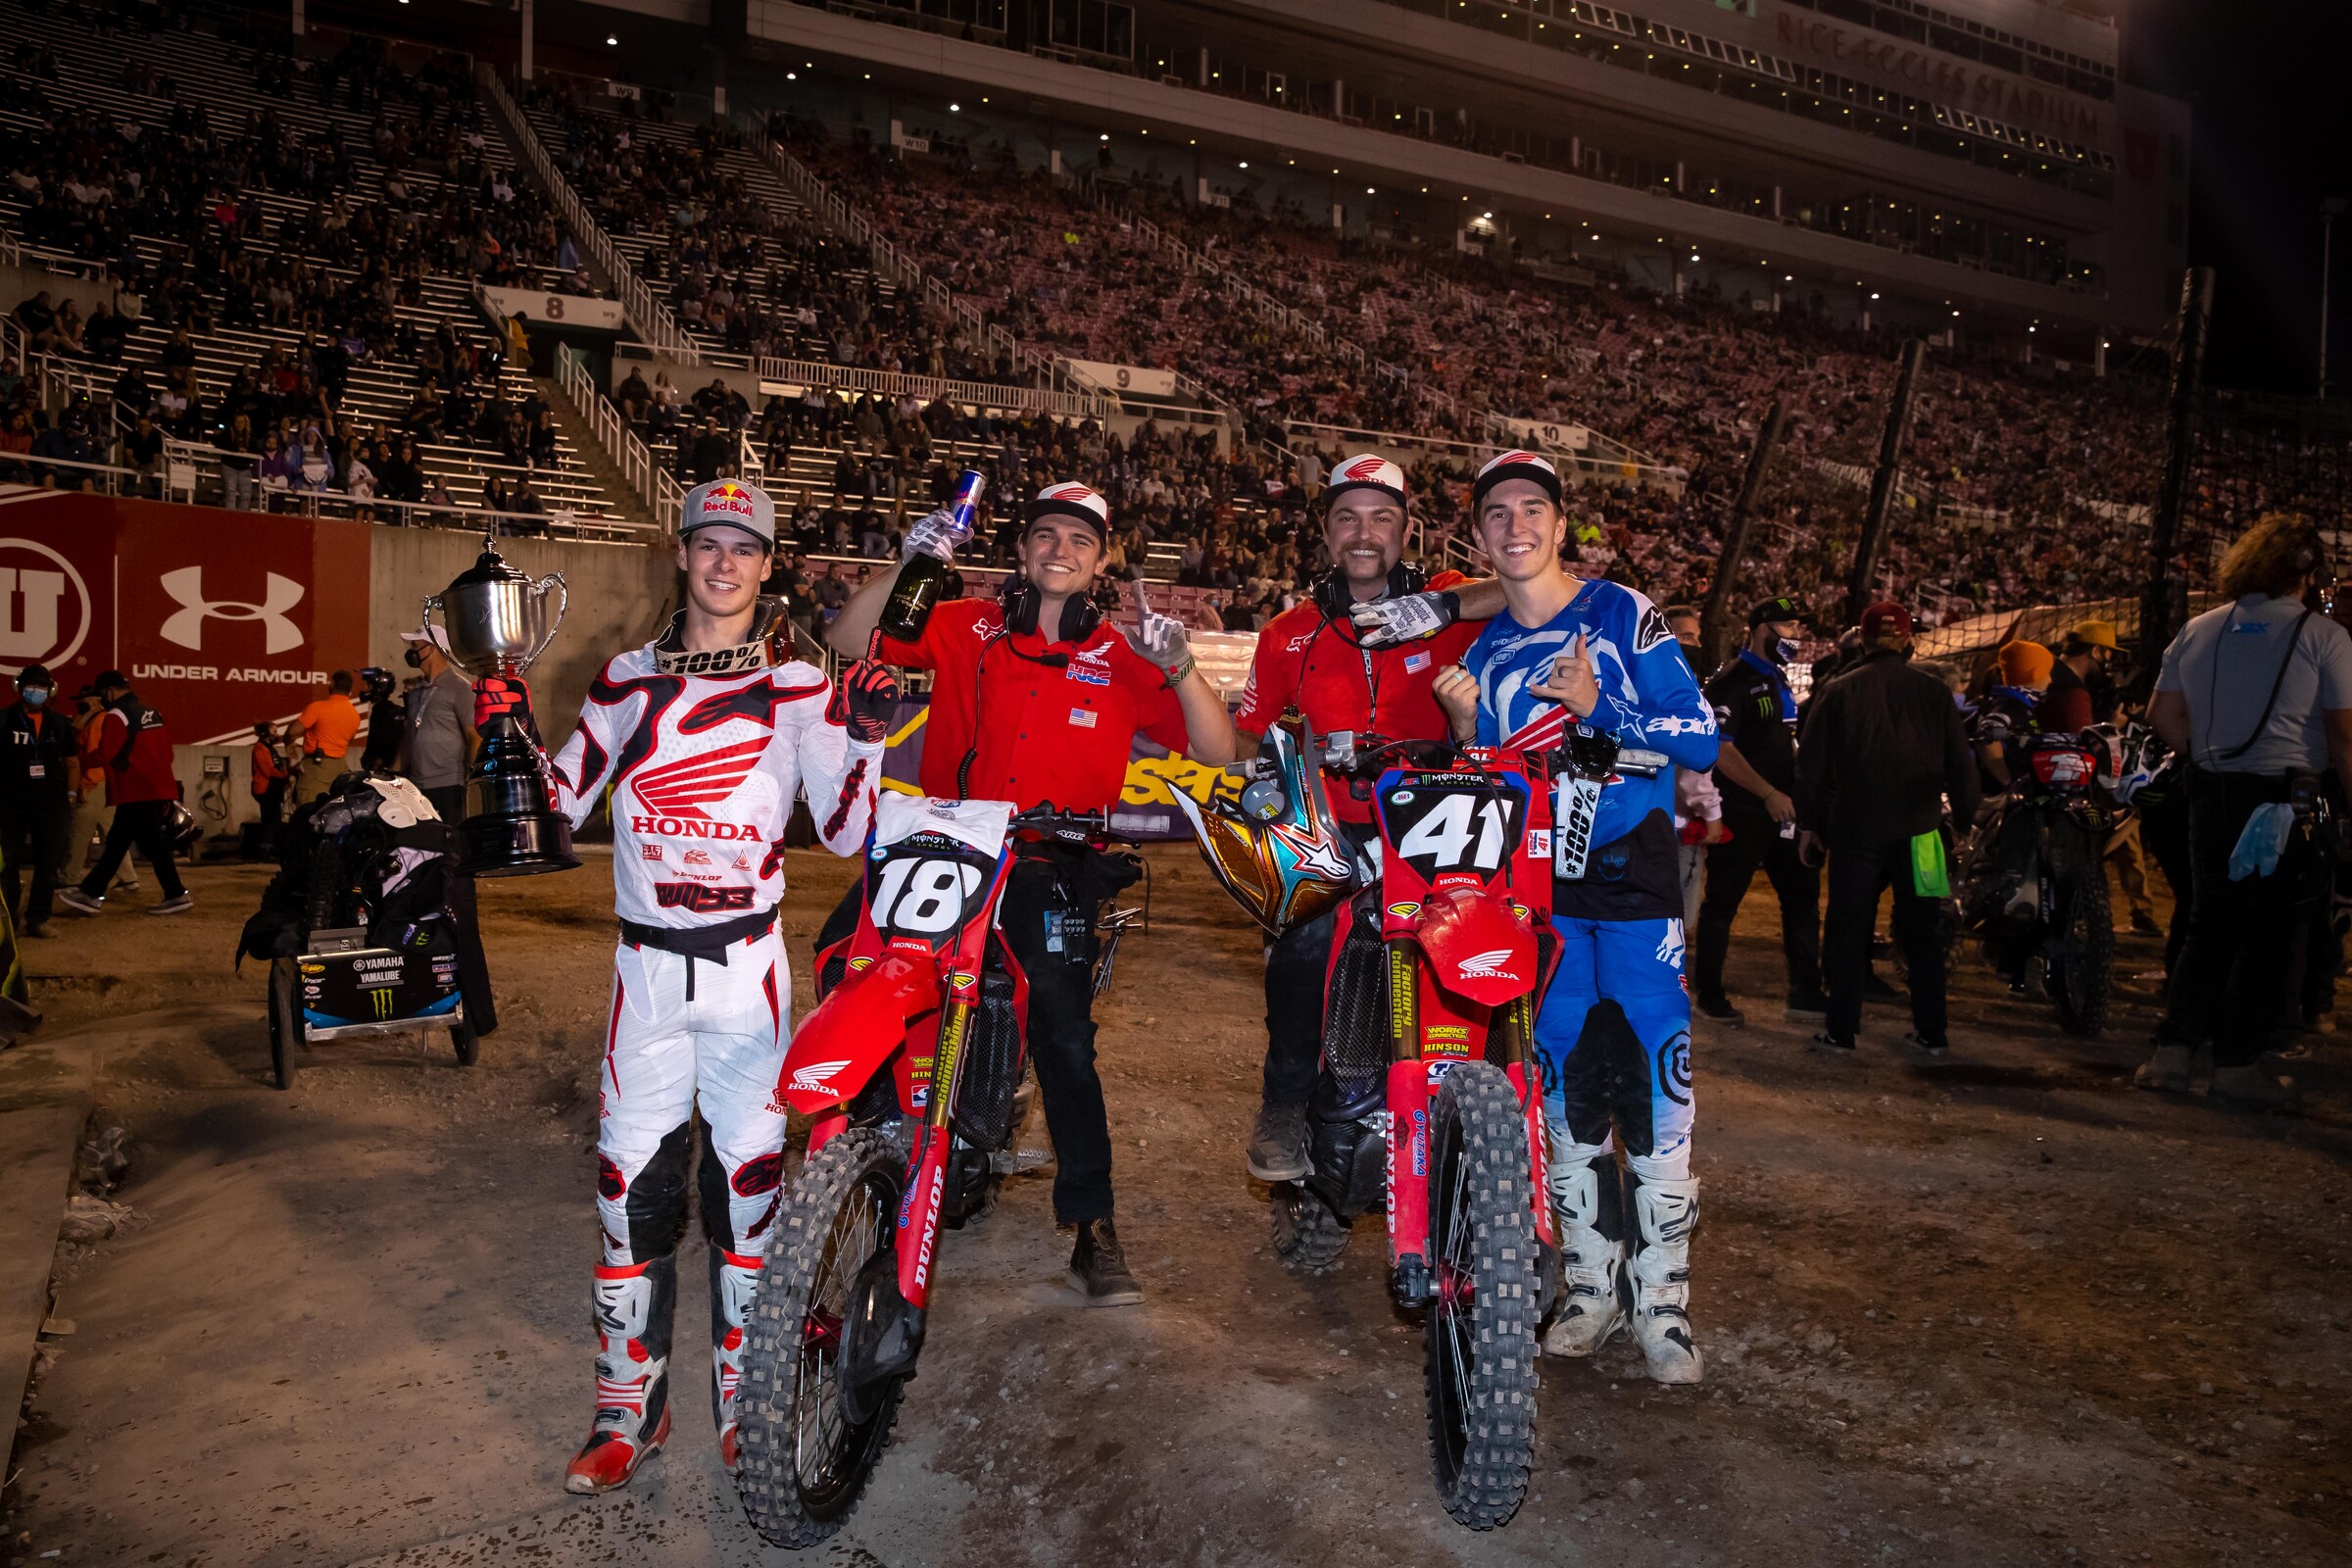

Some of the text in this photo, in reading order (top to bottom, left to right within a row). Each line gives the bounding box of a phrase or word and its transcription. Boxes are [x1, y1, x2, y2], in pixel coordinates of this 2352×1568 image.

[1973, 74, 2098, 136] STADIUM
[905, 138, 926, 150] W10
[546, 296, 564, 319] 8
[1116, 368, 1131, 388] 9
[1542, 425, 1559, 442] 10
[704, 500, 753, 518] Red Bull
[132, 663, 219, 681] UNDER
[1066, 662, 1111, 686] HRC
[13, 730, 29, 745] 17
[1432, 772, 1485, 783] MONSTER
[631, 815, 763, 843] HONDA
[1056, 829, 1086, 841] ARC
[1398, 794, 1513, 870] 41
[1538, 837, 1548, 852] 41
[1439, 877, 1478, 886] HONDA
[870, 857, 982, 933] 18
[892, 942, 927, 952] HONDA
[365, 956, 405, 970] YAMAHA
[360, 970, 401, 984] YAMALUBE
[1459, 970, 1521, 981] HONDA
[1424, 1043, 1470, 1054] HINSON
[787, 1083, 840, 1098] HONDA
[1416, 1123, 1426, 1176] YUTAKA
[1386, 1110, 1396, 1234] DUNLOP
[1537, 1105, 1553, 1233] DUNLOP
[914, 1164, 944, 1290] DUNLOP
